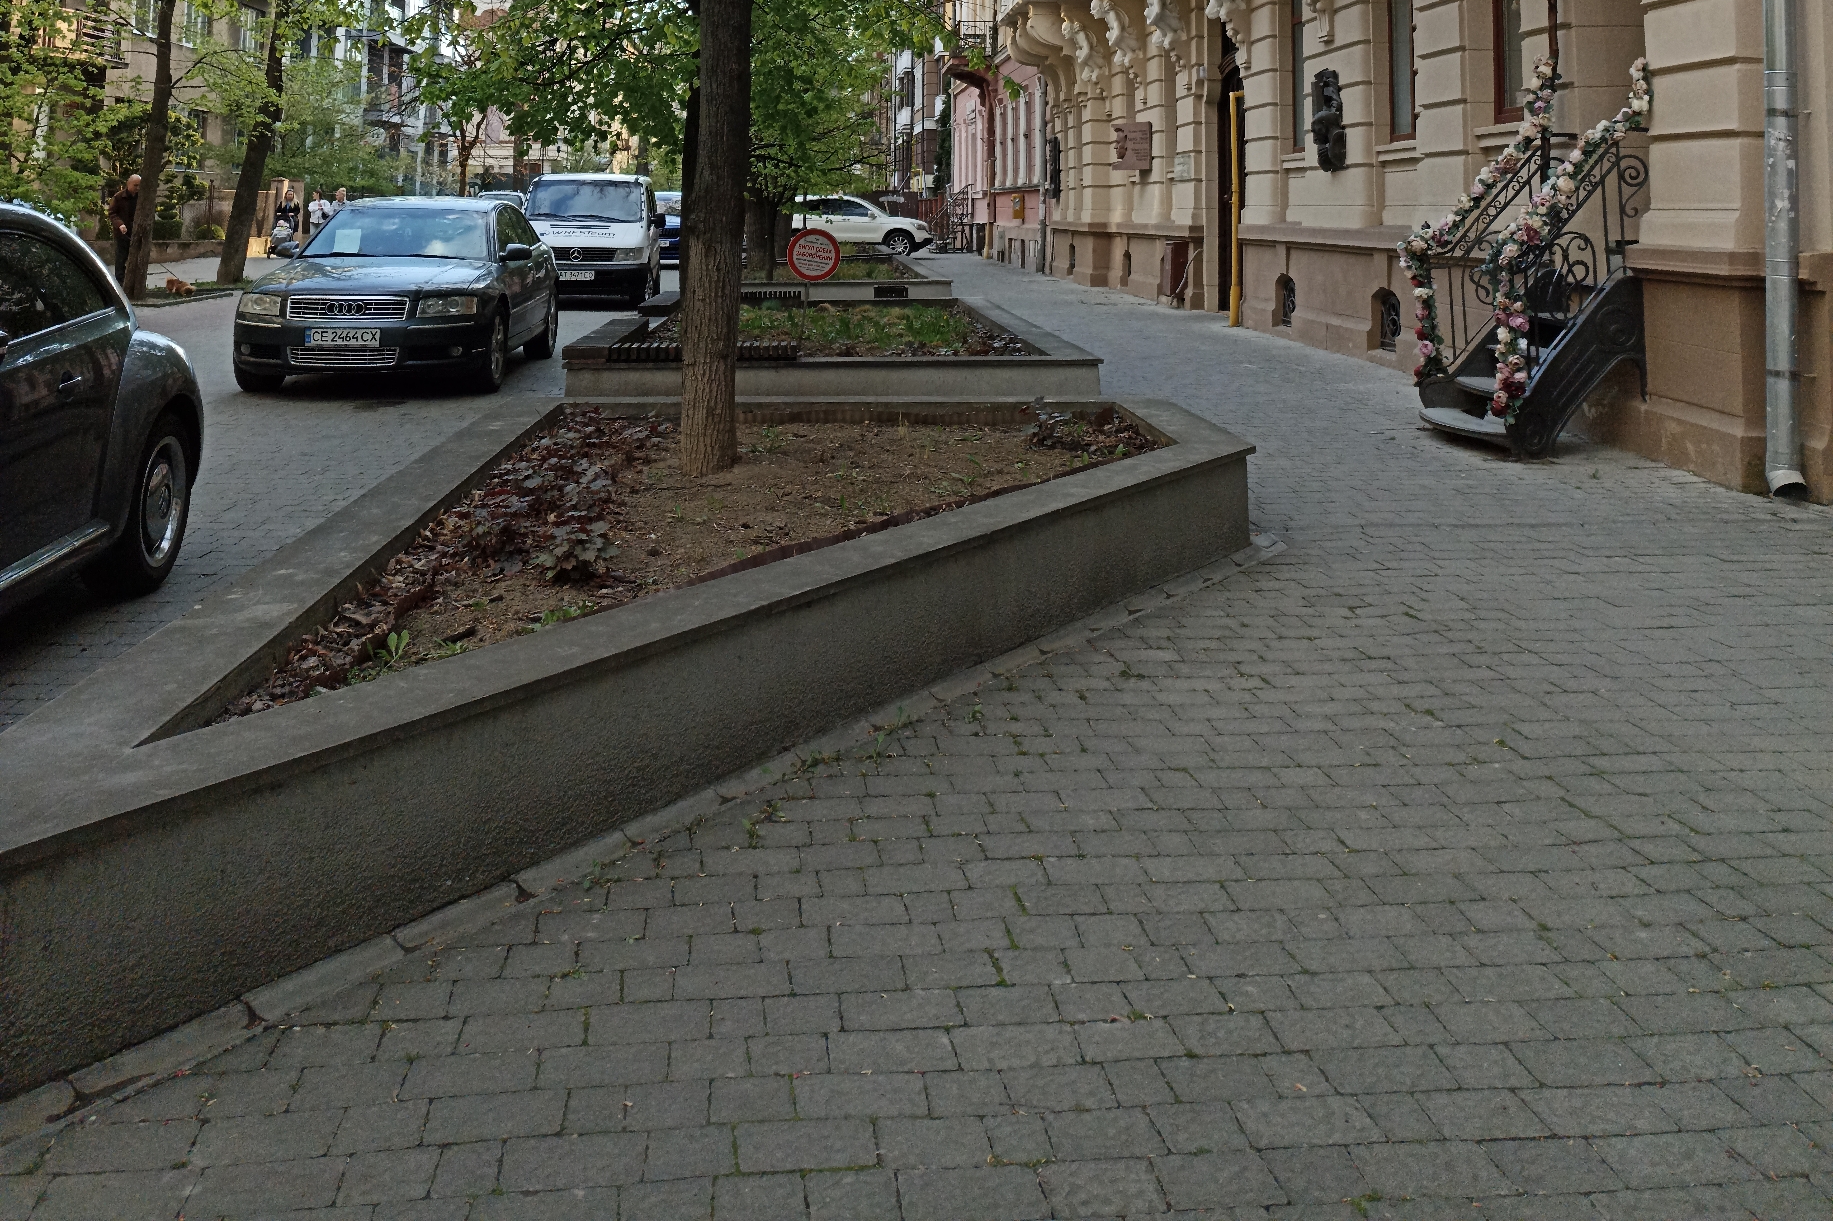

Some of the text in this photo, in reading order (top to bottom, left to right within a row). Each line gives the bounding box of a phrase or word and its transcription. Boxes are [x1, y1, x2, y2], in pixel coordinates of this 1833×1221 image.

[312, 331, 378, 342] CE 2464 CX
